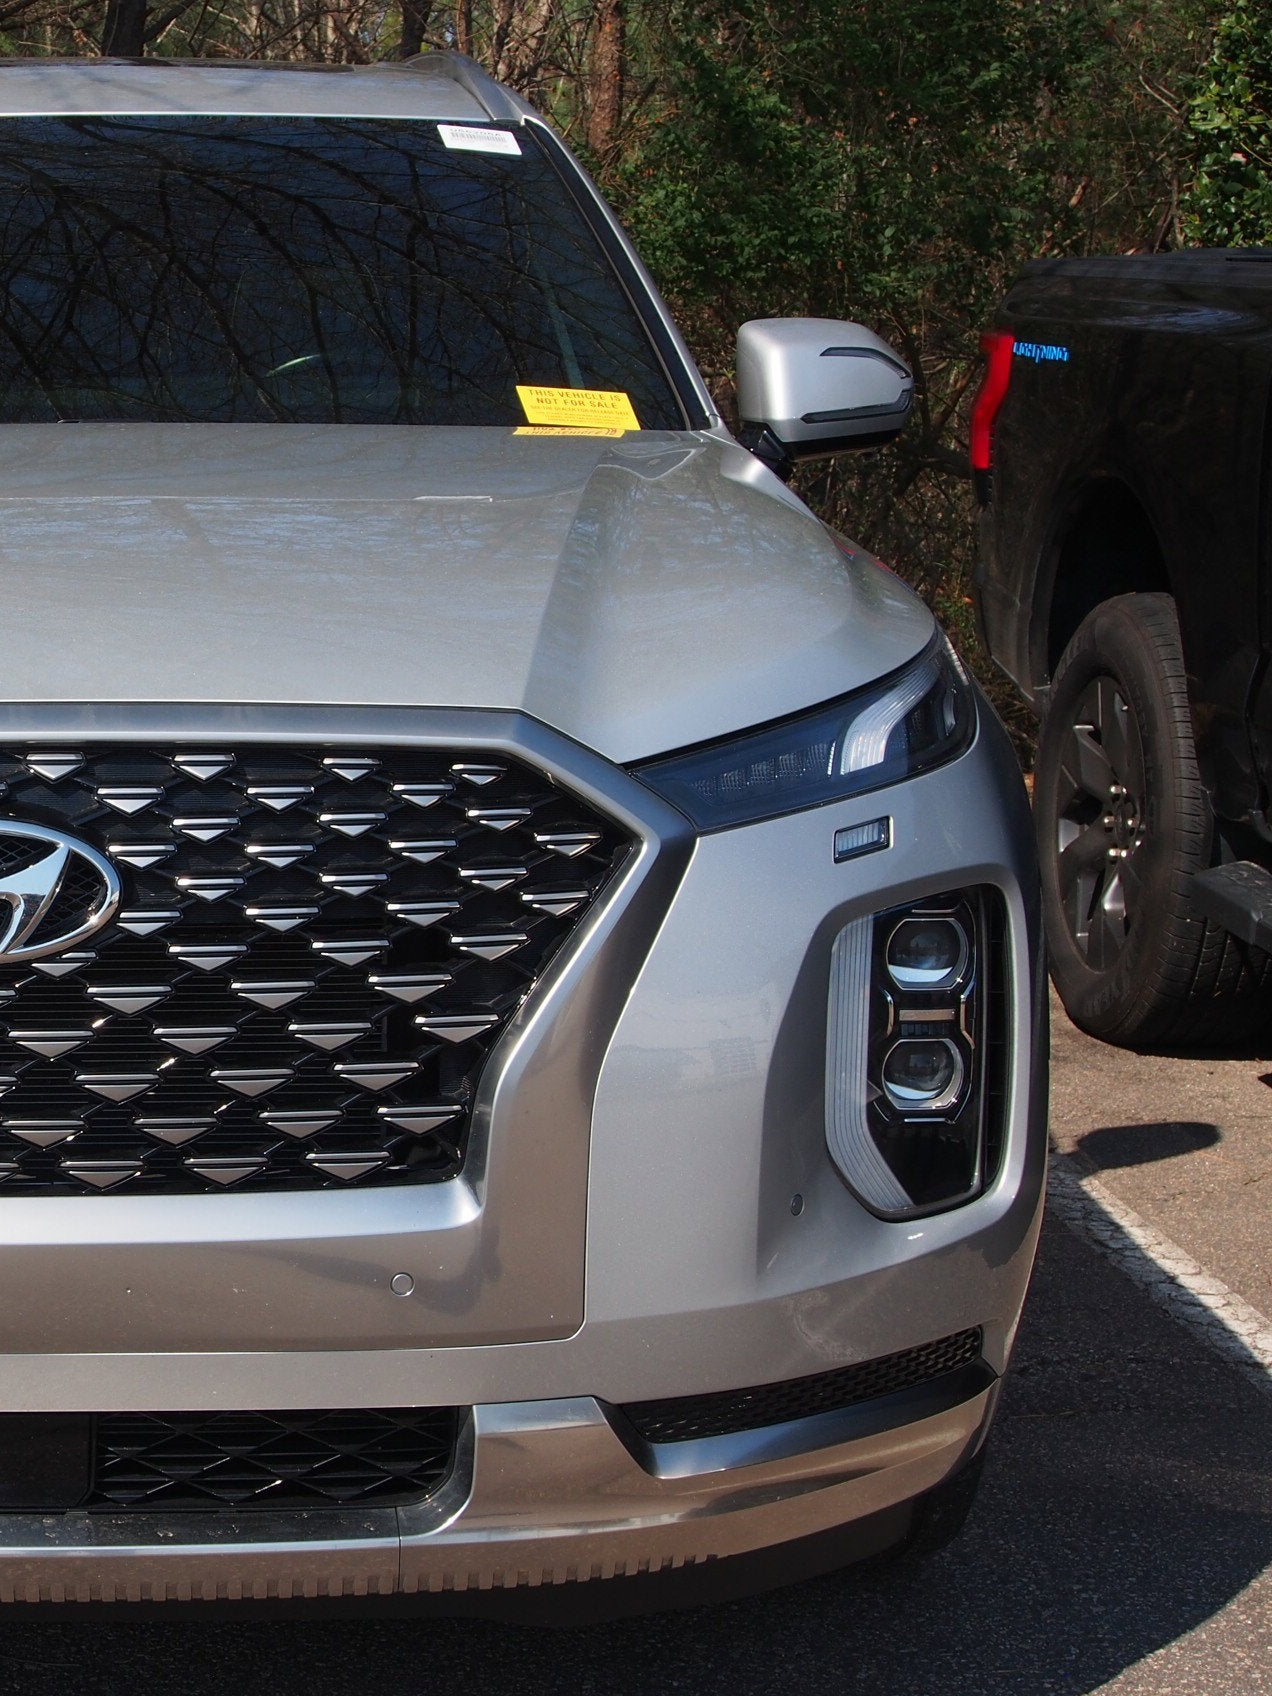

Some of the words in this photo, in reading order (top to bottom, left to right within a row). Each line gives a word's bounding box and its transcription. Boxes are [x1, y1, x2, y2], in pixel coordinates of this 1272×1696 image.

[528, 389, 555, 397] THIS
[557, 390, 605, 401] VEHICLE
[609, 394, 622, 402] IS
[536, 397, 559, 405] NOT
[564, 399, 586, 407] FOR
[590, 401, 619, 409] SALE
